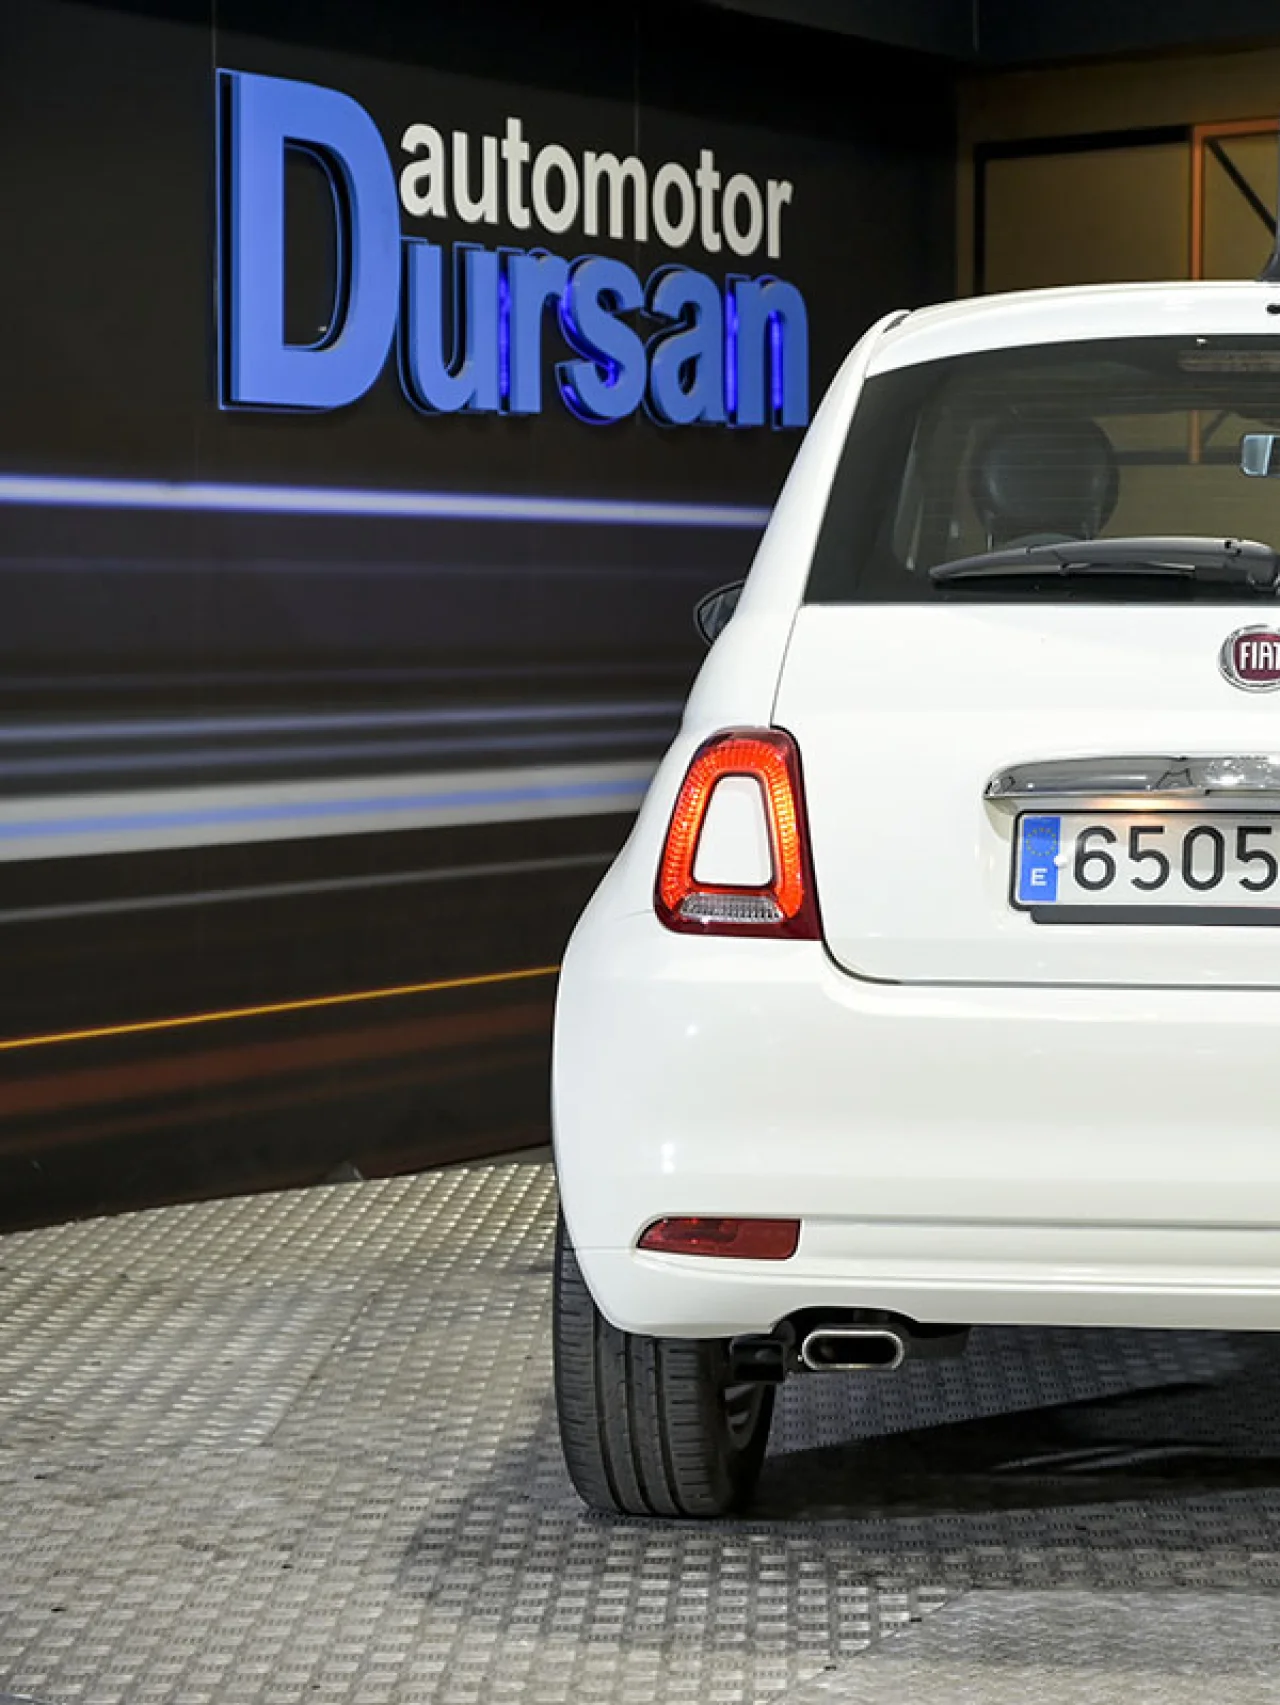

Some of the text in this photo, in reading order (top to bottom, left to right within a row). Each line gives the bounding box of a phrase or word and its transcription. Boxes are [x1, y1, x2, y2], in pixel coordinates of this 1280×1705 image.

[400, 117, 794, 259] automotor
[216, 68, 810, 430] Dursan
[1030, 867, 1047, 887] E
[1073, 825, 1279, 892] 6505
